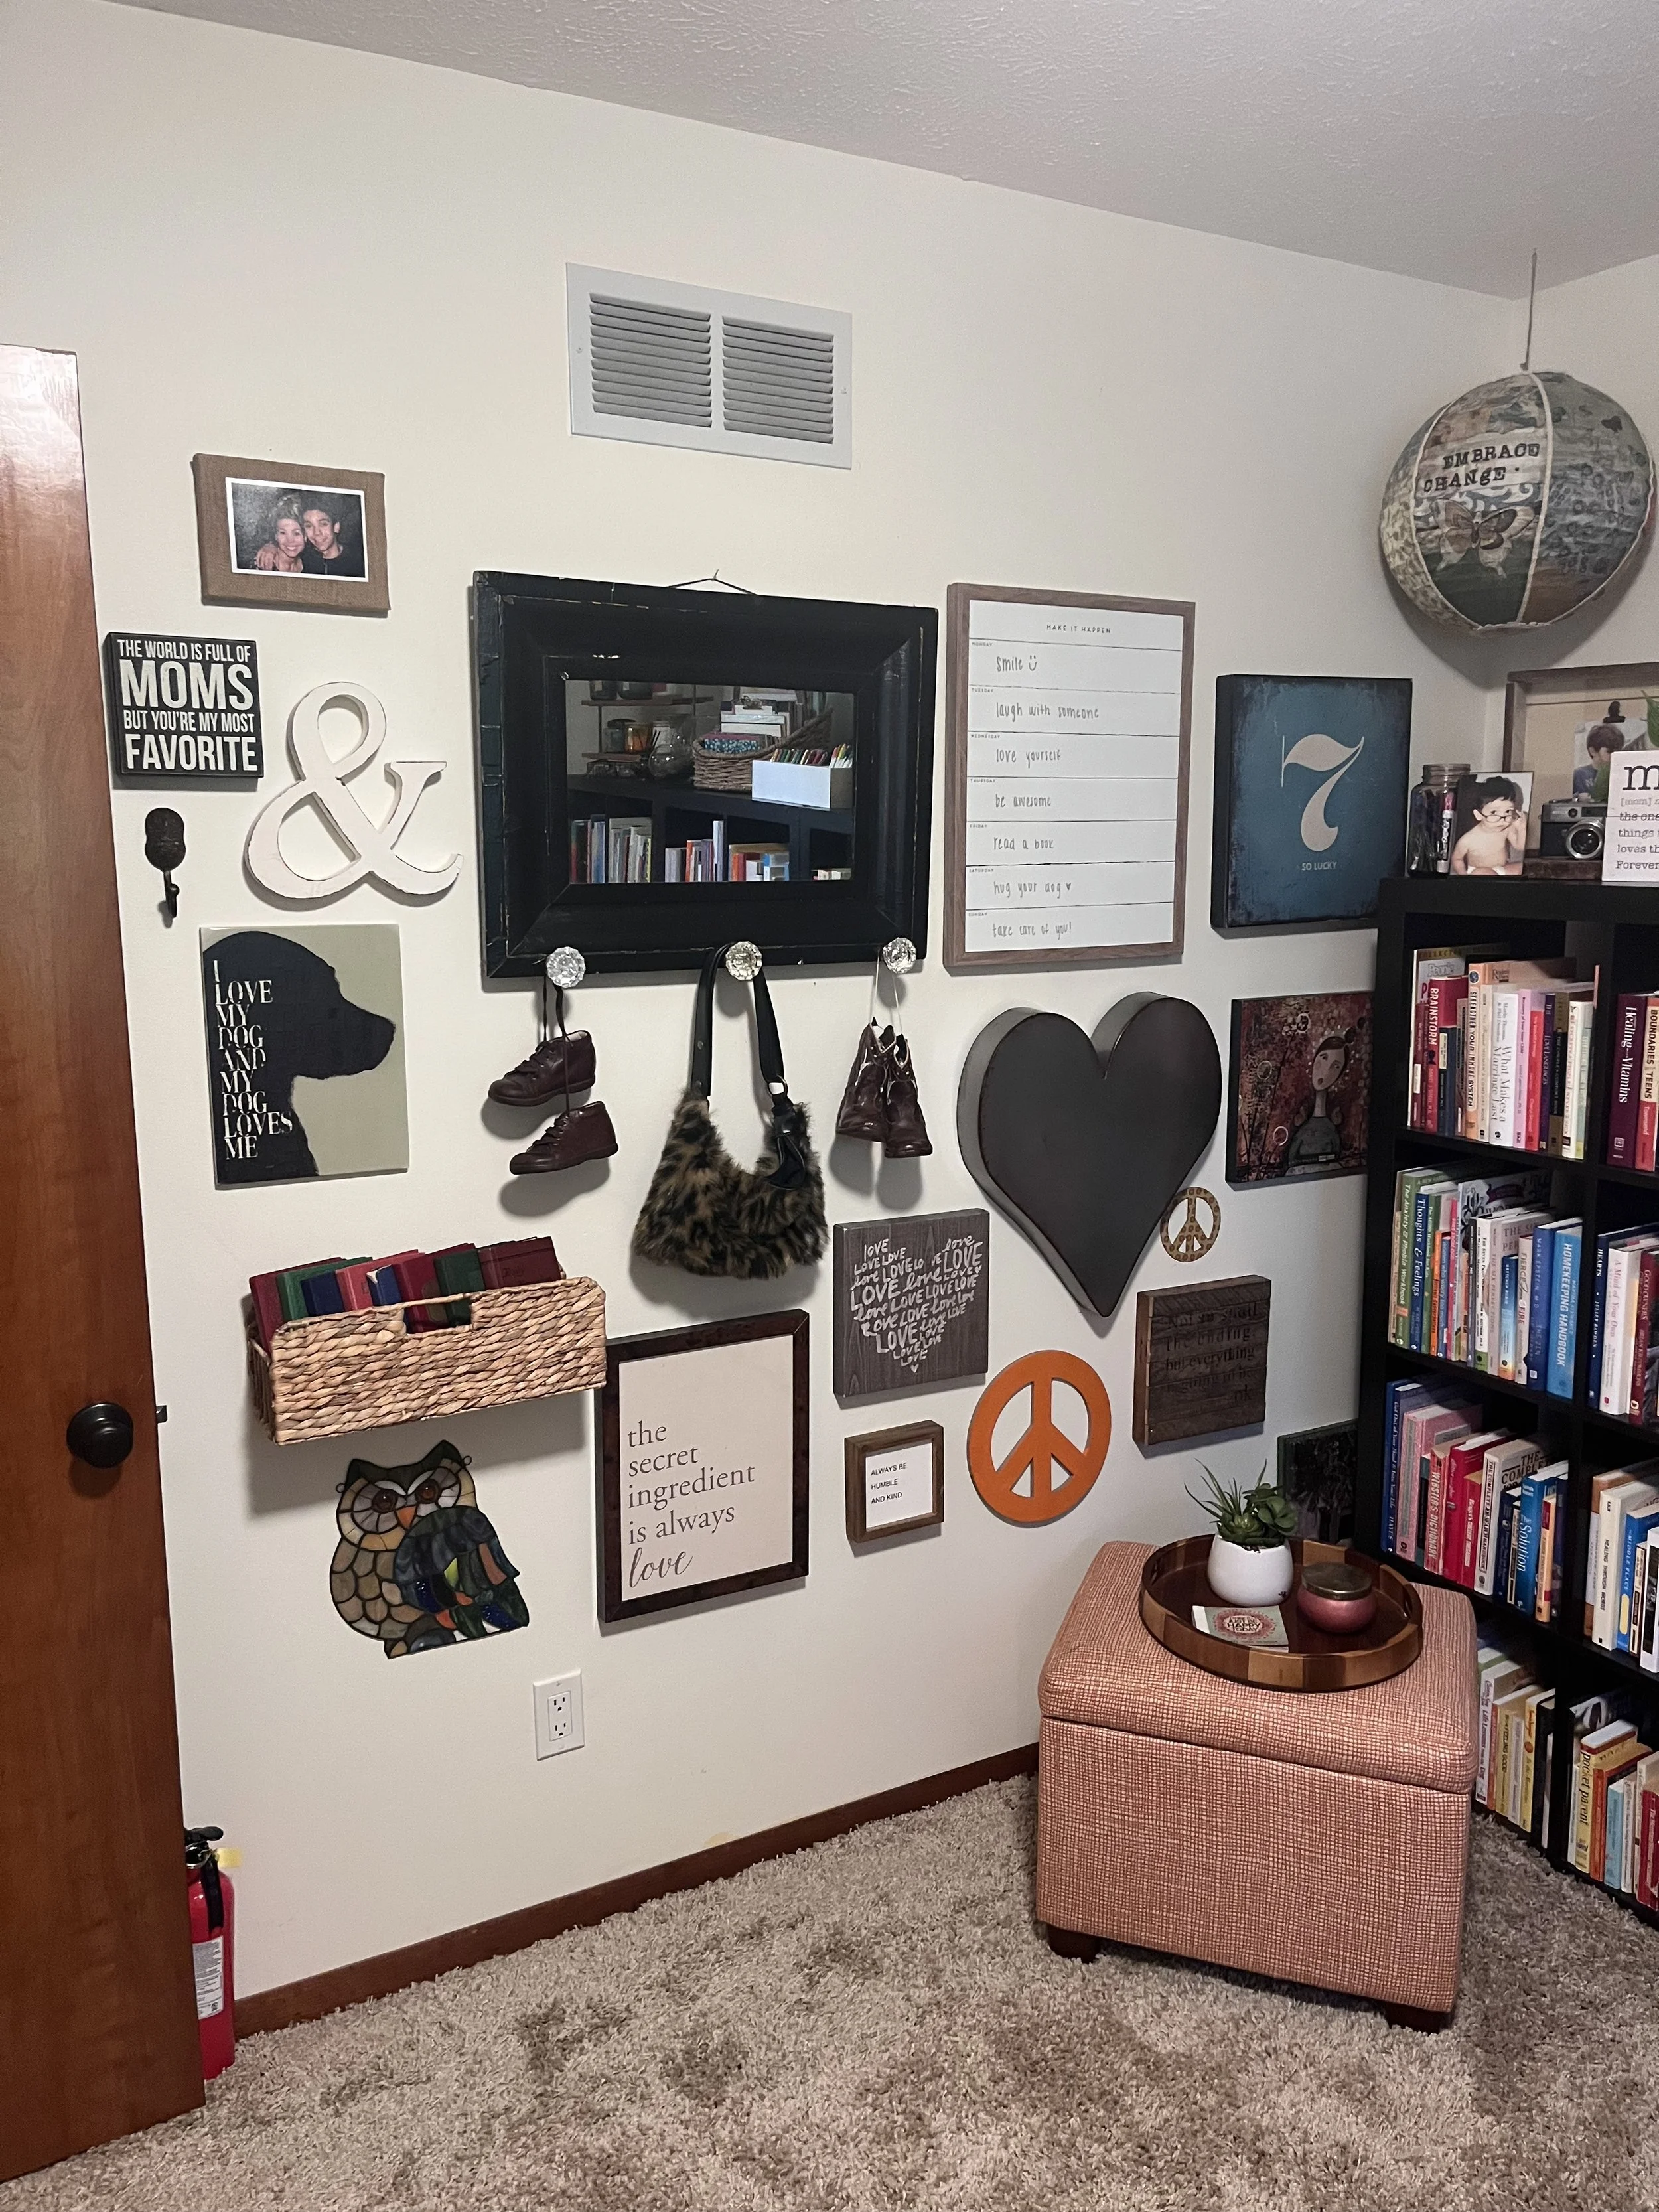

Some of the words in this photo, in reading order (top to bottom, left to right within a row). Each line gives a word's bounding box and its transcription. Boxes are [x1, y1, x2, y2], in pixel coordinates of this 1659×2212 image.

[117, 639, 143, 658] THE
[145, 642, 188, 660] WORLD
[191, 643, 202, 660] IS
[205, 644, 234, 662] FULL
[236, 646, 251, 662] OF
[997, 656, 1023, 672] smile
[119, 660, 253, 710] MOMS
[123, 710, 147, 729] BUT
[151, 711, 195, 731] YOU'RE
[200, 713, 218, 732] MY
[221, 713, 255, 733] MOST
[996, 702, 1023, 722] laugh
[1029, 703, 1050, 717] with
[1058, 707, 1100, 720] someone
[125, 733, 257, 771] FAVORITE
[995, 748, 1017, 763] love
[1026, 749, 1061, 769] yourself
[995, 794, 1005, 808] be
[1013, 796, 1051, 808] awesome
[1281, 733, 1365, 852] 7
[1619, 812, 1638, 822] the
[993, 836, 1015, 851] read
[1022, 838, 1029, 850] a
[1034, 838, 1054, 849] book
[1619, 829, 1654, 839] things
[1617, 844, 1646, 853] loves
[1301, 862, 1311, 871] SO
[1313, 861, 1338, 870] LUCKY
[993, 881, 1011, 898] hug
[1017, 883, 1037, 898] your
[1045, 882, 1061, 899] dog
[992, 922, 1013, 938] take
[1019, 923, 1036, 936] care
[1041, 922, 1049, 934] of
[1055, 922, 1072, 940] you!
[214, 960, 220, 982] I
[216, 980, 273, 1005] LOVE
[216, 1004, 250, 1027] MY
[1428, 988, 1439, 1045] BRAINSTORM
[1469, 992, 1478, 1028] STRENGTHEN
[218, 1025, 263, 1050] DOG
[1621, 1007, 1637, 1049] Healing
[1647, 1009, 1658, 1065] BOUNDARIES
[223, 1047, 266, 1072] AND
[1491, 1046, 1502, 1095] Marriage
[1500, 1046, 1512, 1074] What
[1542, 1052, 1551, 1086] LANGUAGES
[220, 1070, 253, 1094] MY
[1618, 1057, 1634, 1103] Vitamins
[1644, 1071, 1654, 1100] TEENS
[223, 1091, 267, 1116] DOG
[1500, 1078, 1511, 1114] Makes
[1491, 1099, 1500, 1120] Last
[224, 1111, 293, 1138] LOVES
[225, 1135, 259, 1160] ME
[1415, 1199, 1426, 1242] Thoughts
[1504, 1226, 1521, 1238] THE
[854, 1257, 881, 1275] LOVE
[882, 1247, 906, 1266] LOVE
[944, 1242, 983, 1273] LOVE
[1414, 1248, 1423, 1258] &
[1412, 1260, 1423, 1297] Feelings
[1560, 1243, 1573, 1312] HOMEKEEPING
[1613, 1290, 1620, 1299] of
[876, 1322, 918, 1353] LOVE
[1557, 1314, 1569, 1367] HANDBOOK
[627, 1420, 667, 1448] the
[628, 1446, 699, 1477] secret
[871, 1464, 897, 1476] ALWAYS
[1521, 1451, 1540, 1466] THE
[628, 1465, 755, 1511] ingredient
[871, 1478, 899, 1490] HUMBLE
[871, 1495, 885, 1504] AND
[887, 1491, 902, 1501] KIND
[628, 1520, 646, 1545] is
[656, 1506, 736, 1538] always
[1517, 1522, 1532, 1572] Solution
[629, 1546, 693, 1588] love
[1581, 1752, 1592, 1789] pocket
[1579, 1788, 1589, 1826] parent
